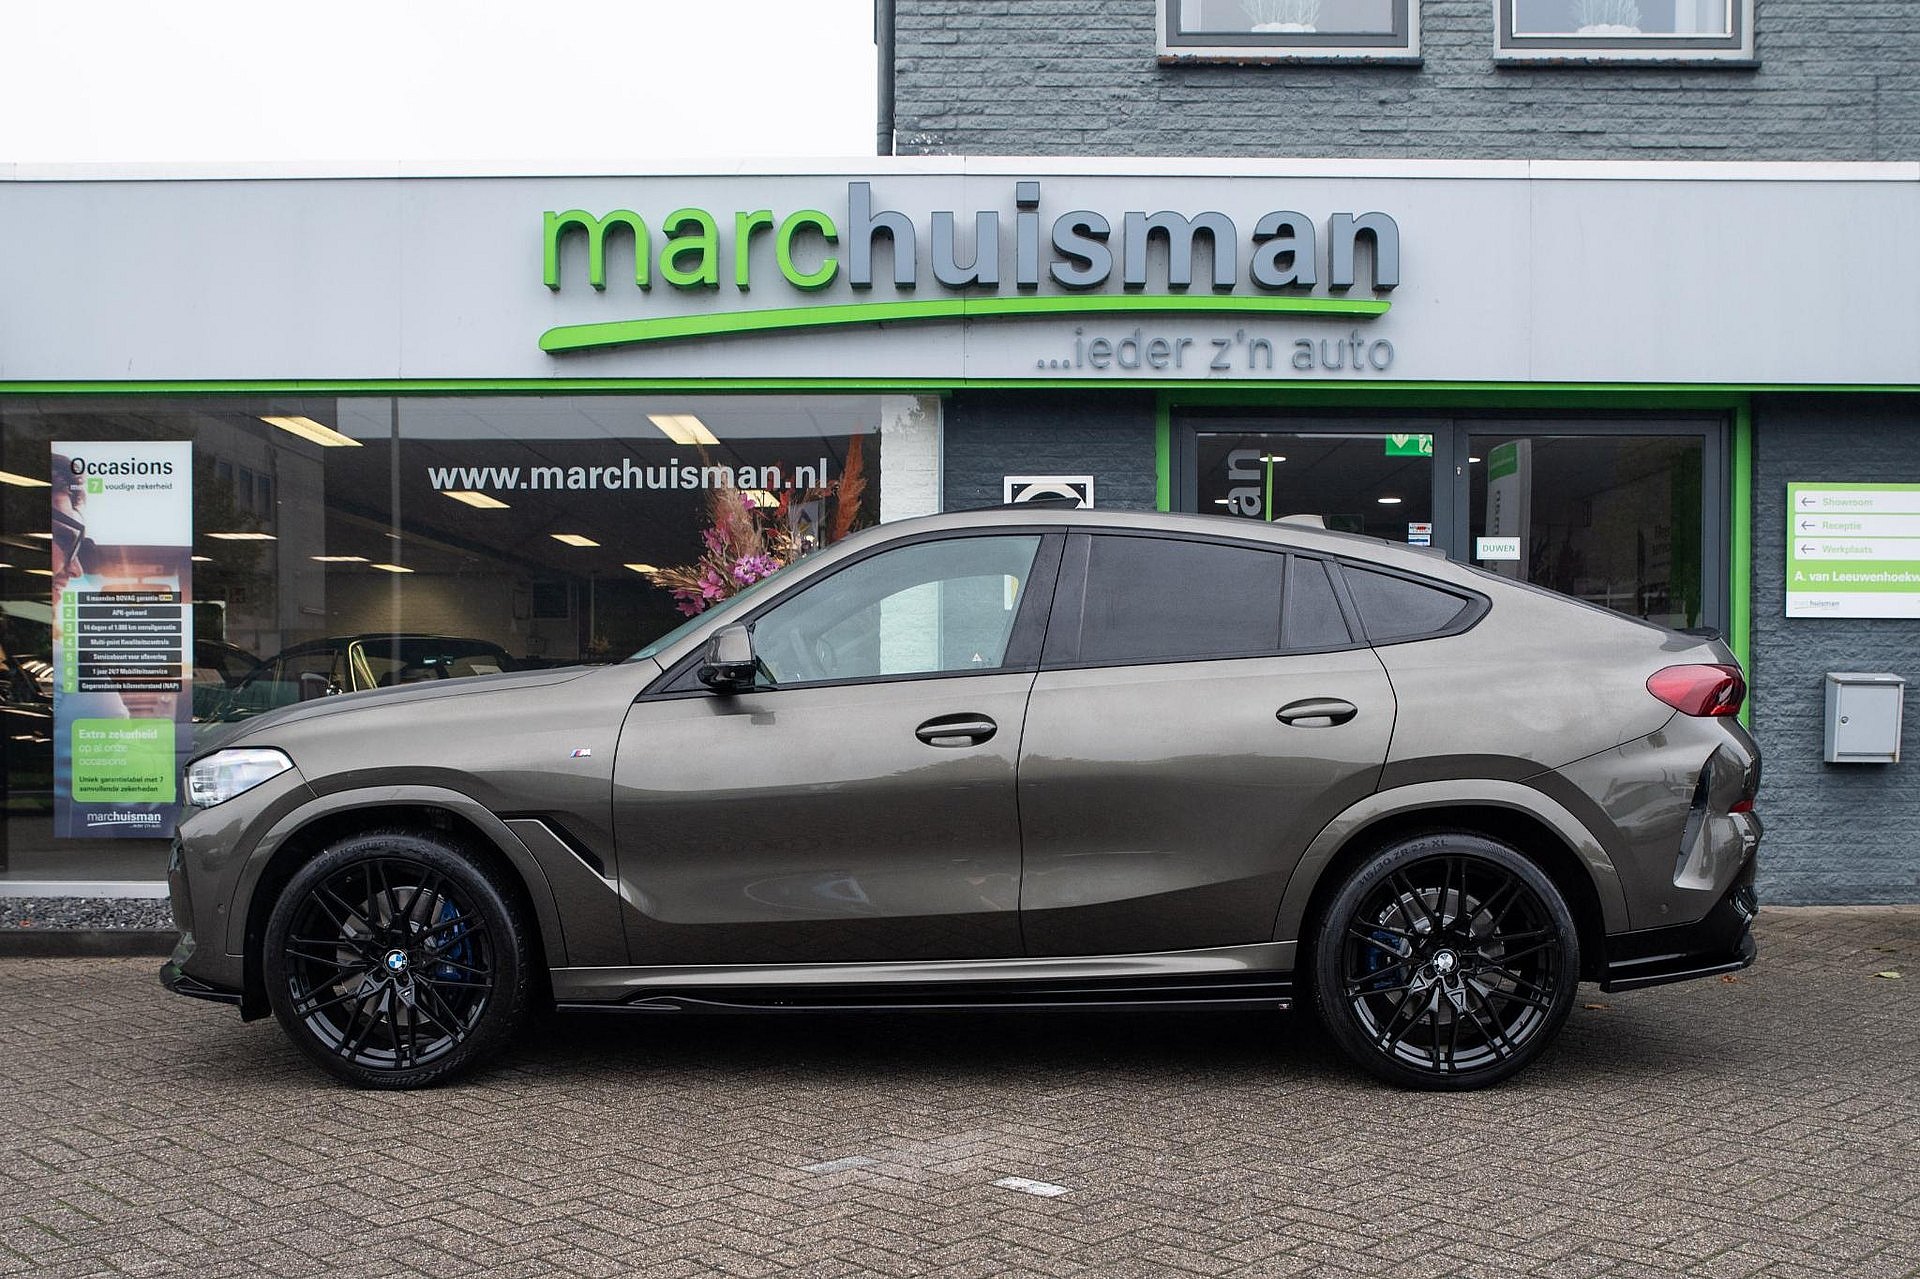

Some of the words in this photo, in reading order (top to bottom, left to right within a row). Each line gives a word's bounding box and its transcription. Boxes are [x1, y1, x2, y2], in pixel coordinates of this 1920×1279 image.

[543, 182, 1399, 291] marchuisman
[1036, 327, 1192, 370] ...ieder
[1210, 328, 1273, 369] z'n
[1292, 328, 1394, 370] auto
[71, 458, 173, 475] Occasions
[428, 458, 827, 490] www.marchuisman.nl
[105, 482, 135, 491] voudige
[137, 481, 173, 490] zekerheid
[1822, 497, 1873, 506] Showroom
[1822, 521, 1862, 531] Receptie
[1822, 545, 1873, 554] Werkplaats
[1794, 570, 1806, 581] A.
[1808, 572, 1830, 581] van
[79, 730, 106, 739] Extra
[108, 729, 157, 739] zekerheid
[79, 775, 98, 783] Uniek
[87, 811, 162, 821] marchuisman
